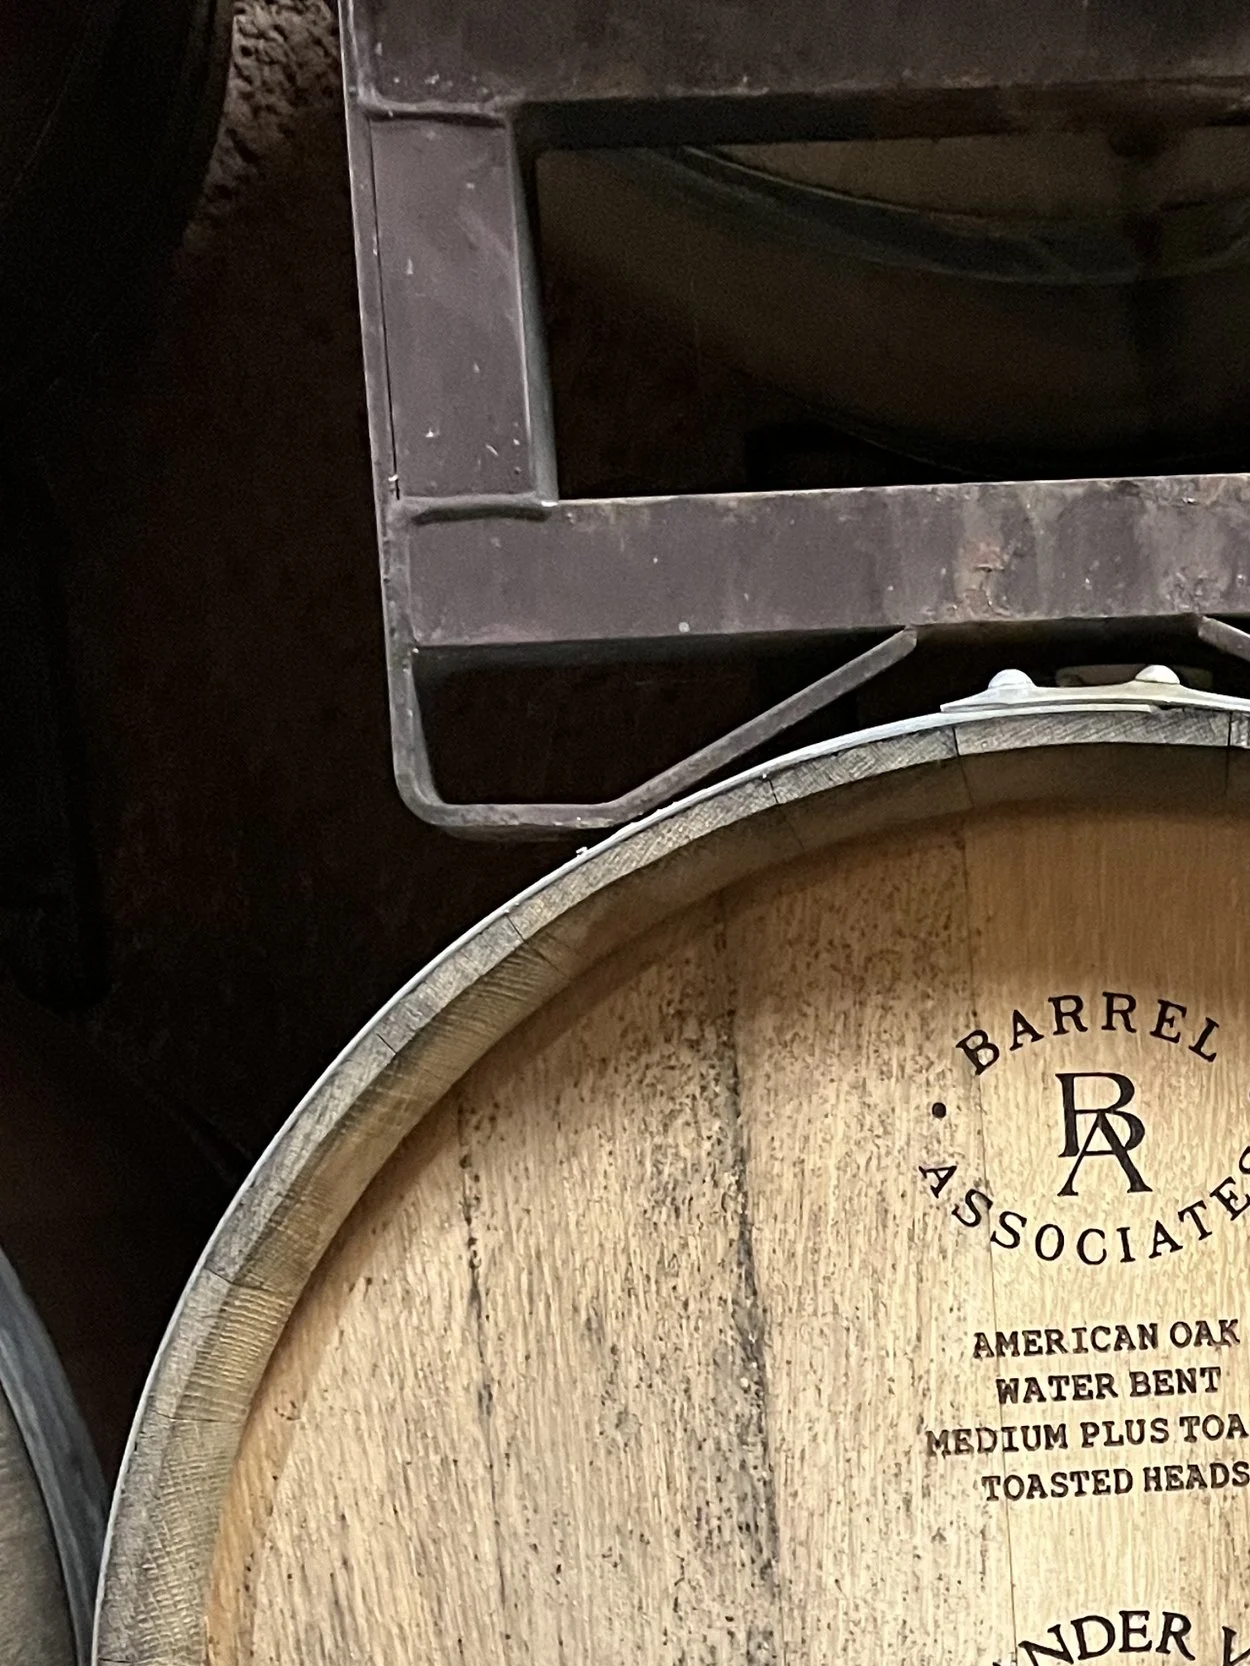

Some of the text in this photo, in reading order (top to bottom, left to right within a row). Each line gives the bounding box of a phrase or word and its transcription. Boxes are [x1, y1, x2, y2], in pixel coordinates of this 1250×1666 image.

[955, 991, 1220, 1076] BARREL
[972, 1318, 1241, 1359] AMERICAN OAK
[995, 1366, 1222, 1405] WATER BENT
[925, 1423, 1069, 1458] MEDIUM
[1079, 1417, 1170, 1449] PLUS
[981, 1461, 1250, 1502] TOASTED HEADS
